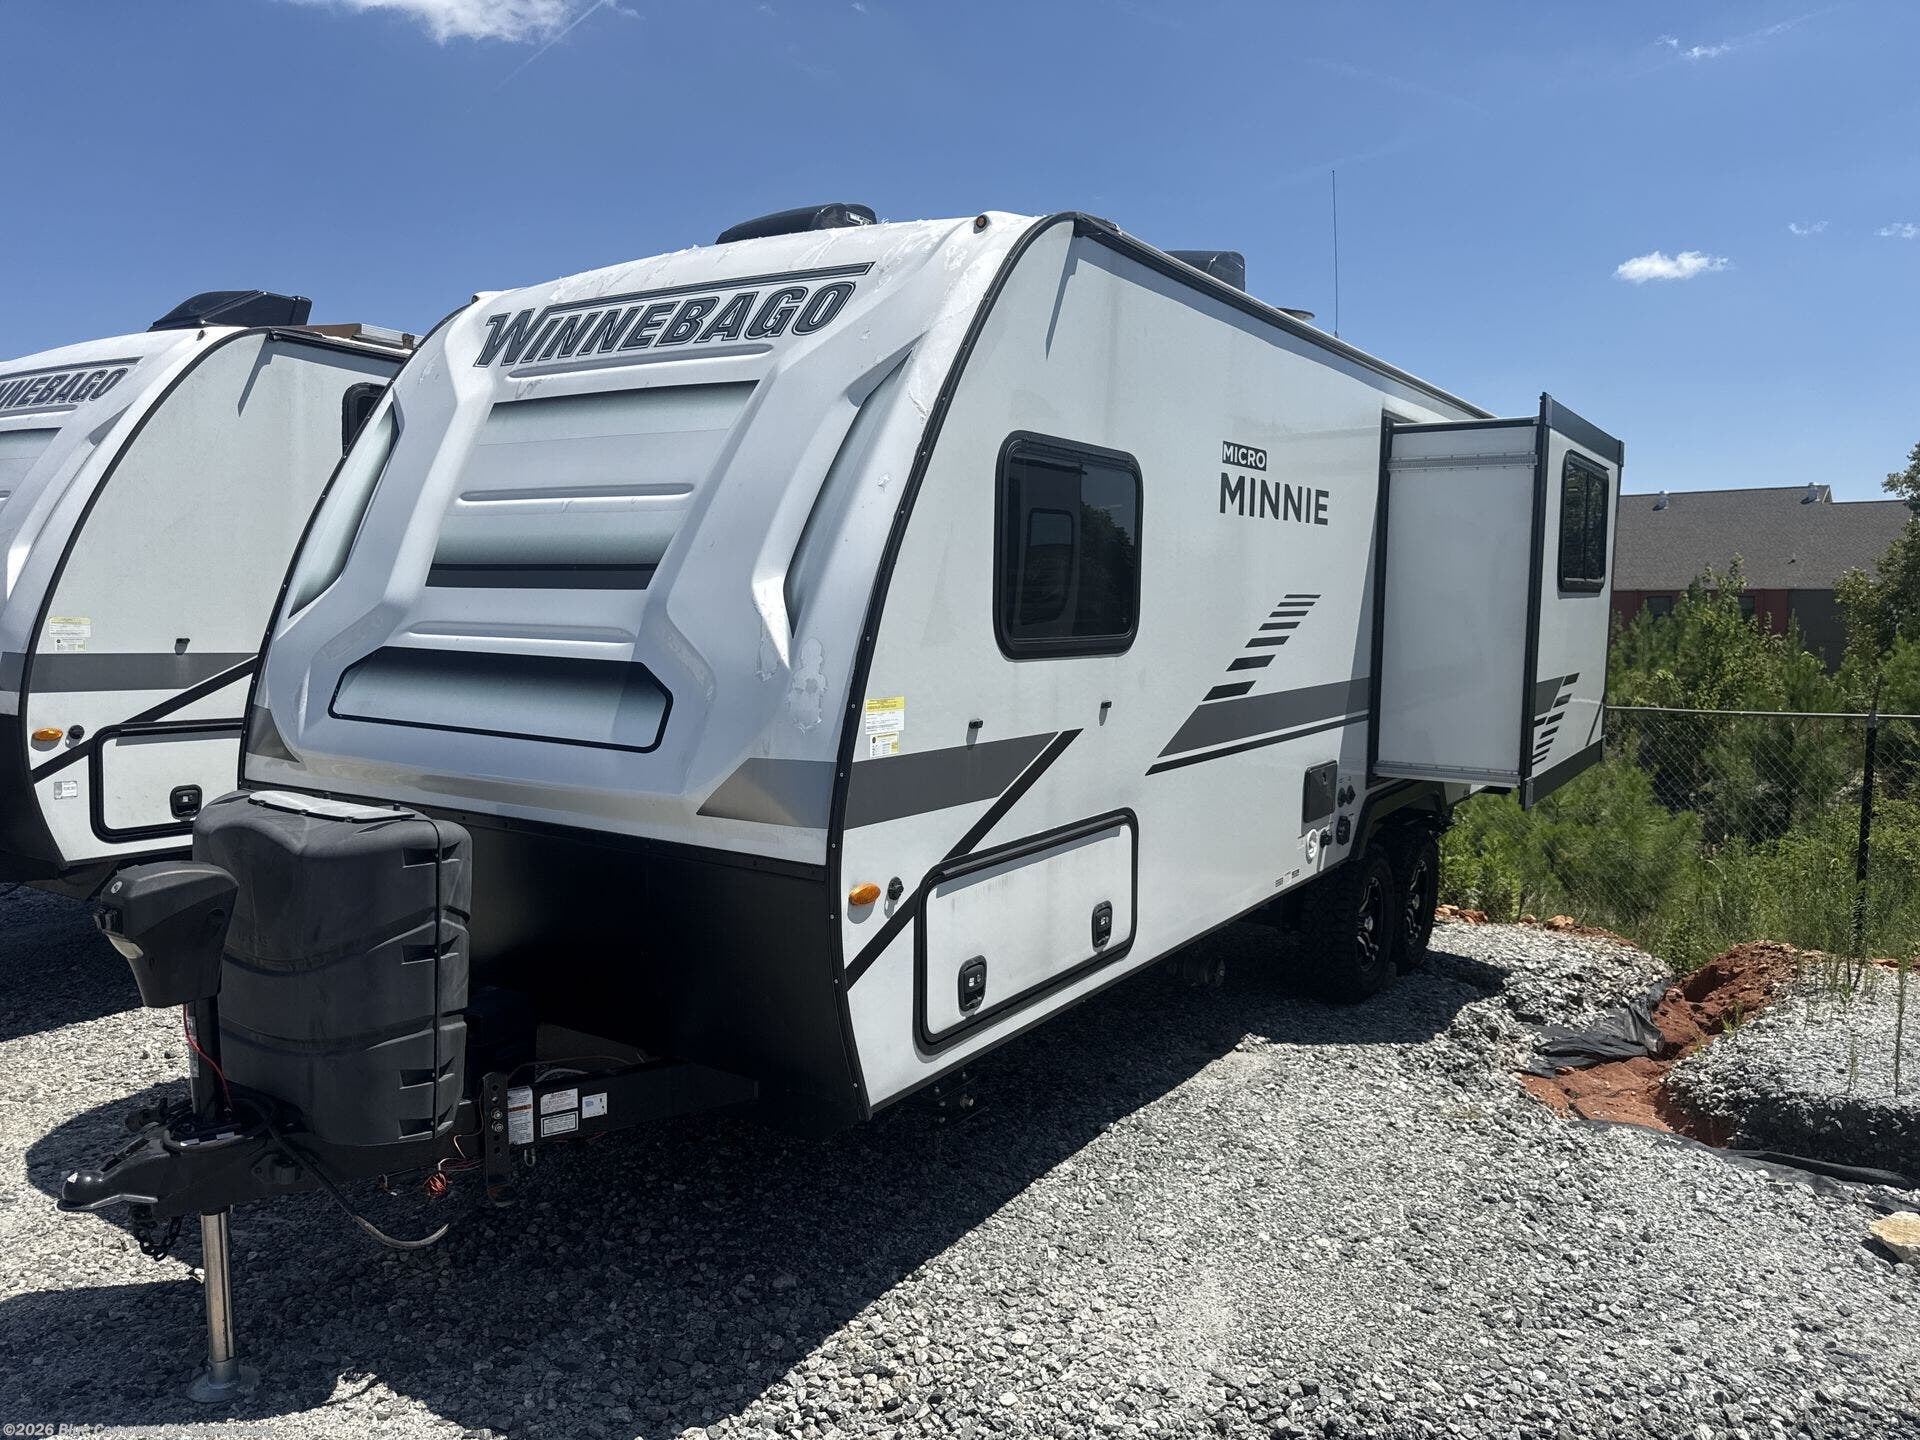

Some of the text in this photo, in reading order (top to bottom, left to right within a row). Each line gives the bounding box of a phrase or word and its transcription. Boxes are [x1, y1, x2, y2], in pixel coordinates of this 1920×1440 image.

[473, 281, 857, 368] WINNEBAGO
[1223, 444, 1266, 468] MICRO
[1220, 472, 1329, 526] MINNIE
